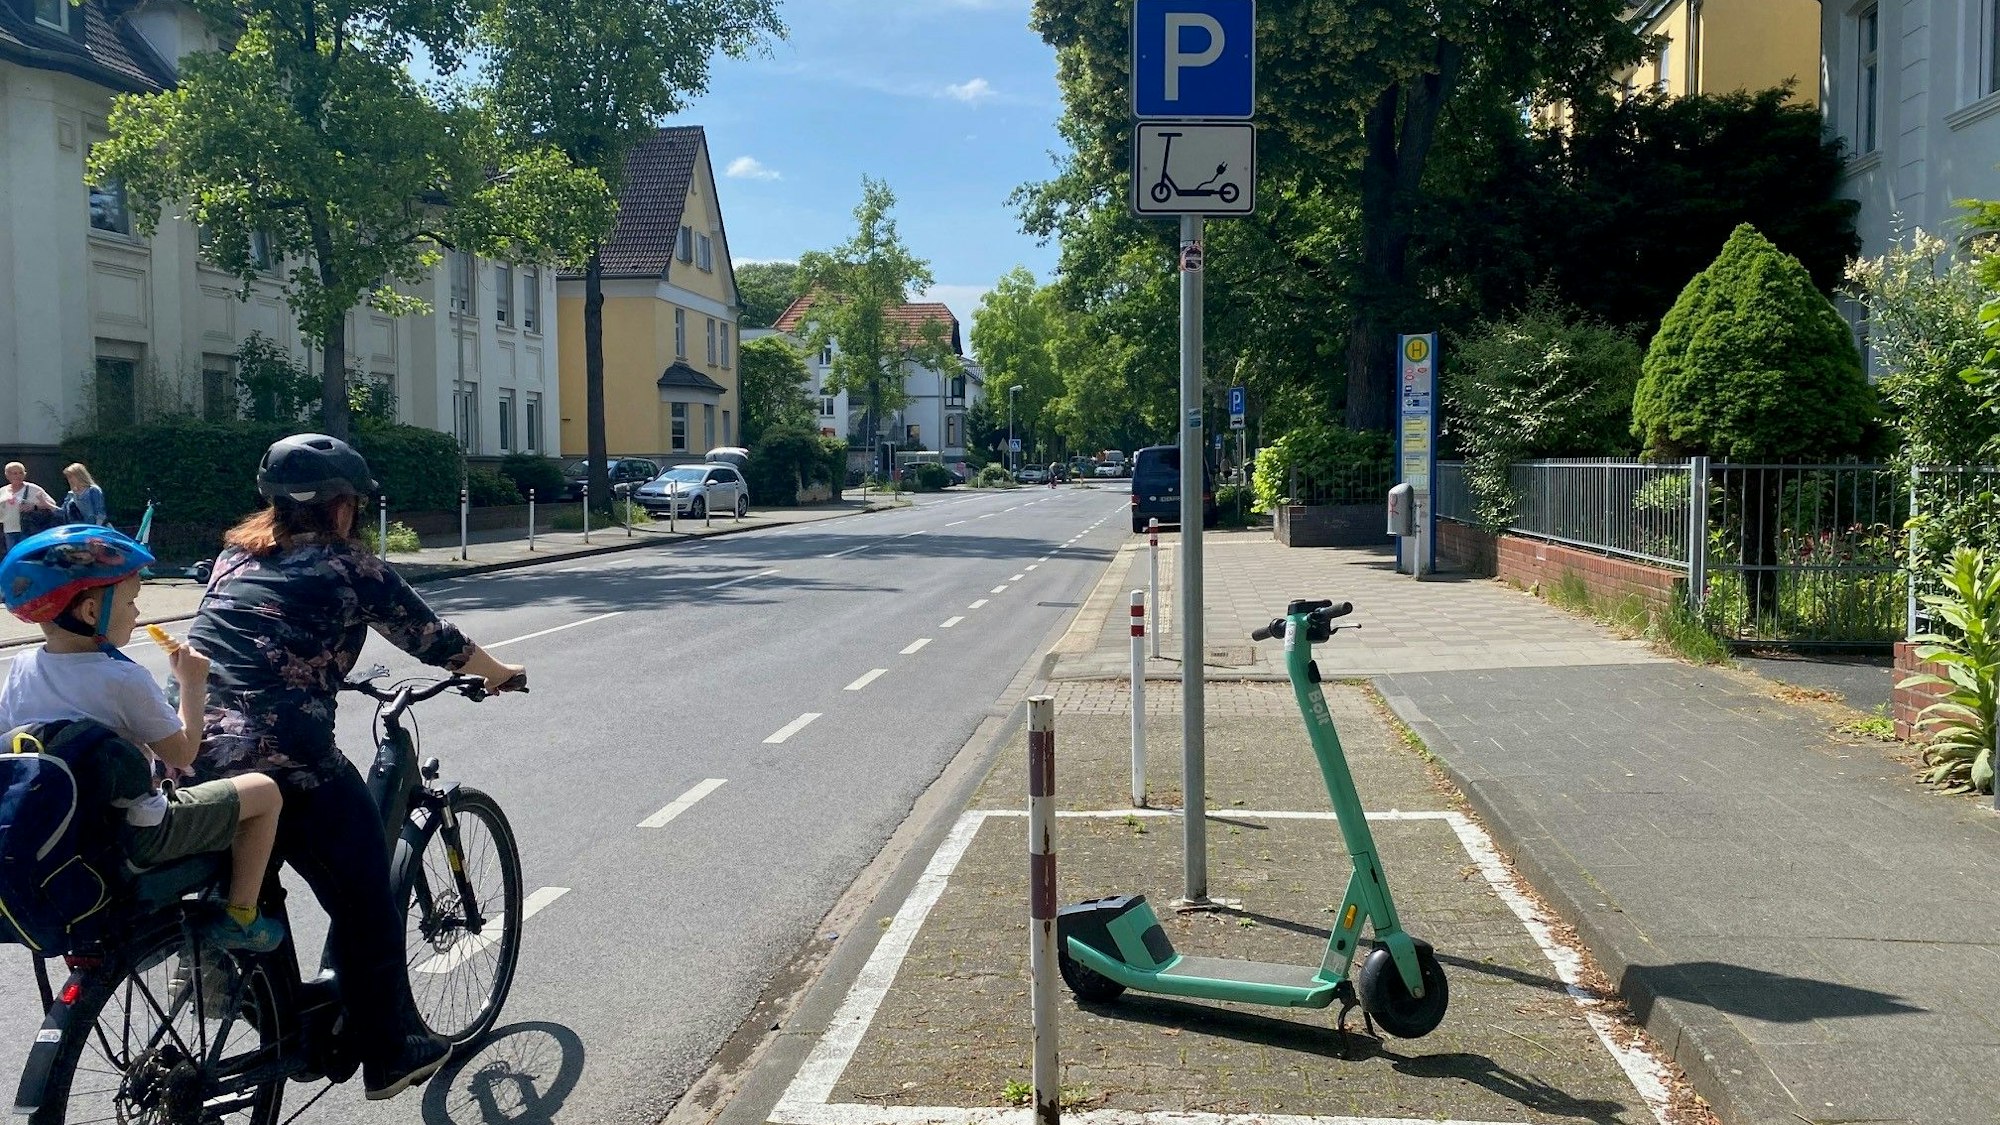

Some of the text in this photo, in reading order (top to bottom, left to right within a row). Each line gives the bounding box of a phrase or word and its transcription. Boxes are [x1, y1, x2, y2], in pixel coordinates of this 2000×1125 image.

[1164, 13, 1225, 101] P
[1411, 342, 1422, 358] H
[1232, 391, 1241, 412] P
[1308, 690, 1330, 725] Bolt
